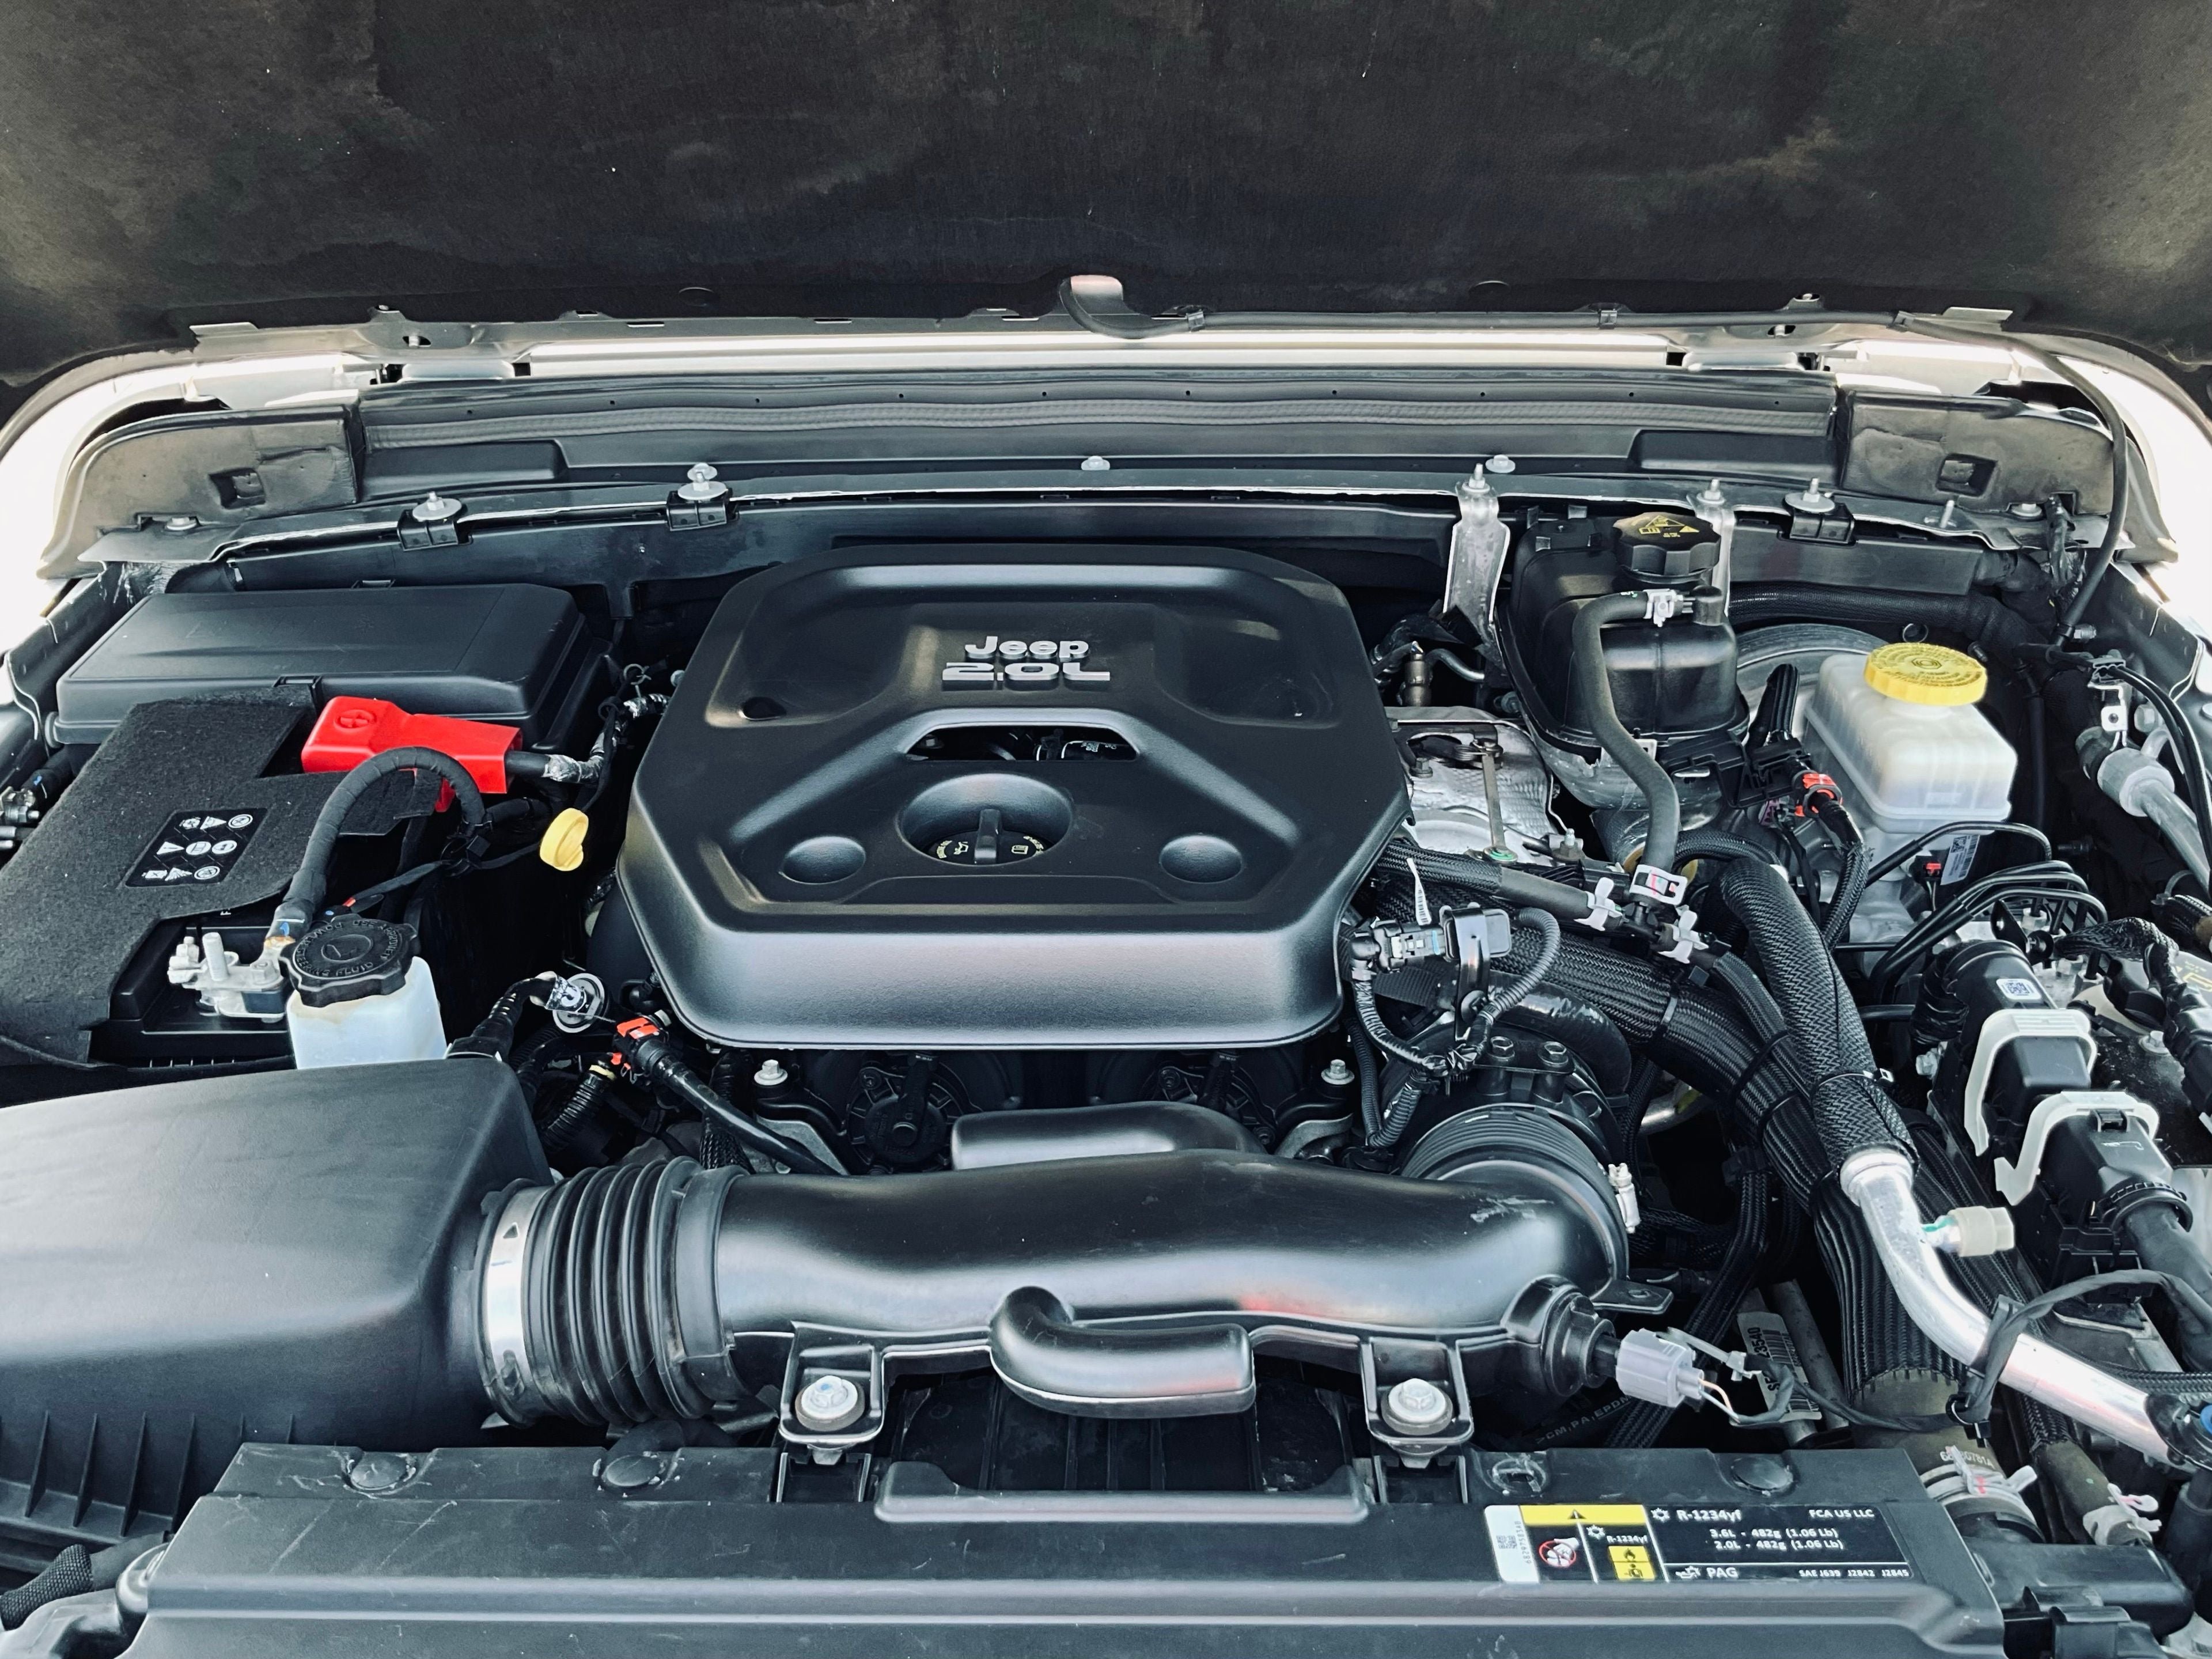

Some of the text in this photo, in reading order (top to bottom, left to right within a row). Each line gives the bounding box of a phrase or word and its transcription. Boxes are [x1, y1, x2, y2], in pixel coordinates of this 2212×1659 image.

[965, 636, 1089, 662] Jeep
[942, 662, 1111, 681] 2.0L
[1676, 1509, 1742, 1522] R-1234yf
[1808, 1509, 1874, 1518] FCA US LLC
[1709, 1528, 1736, 1539] 3.6L
[1751, 1528, 1782, 1539] 482g
[1786, 1528, 1817, 1539] (1.06
[1818, 1528, 1839, 1539] Lb)
[1606, 1535, 1648, 1544] R-1234yf
[1714, 1540, 1741, 1551] 2.0L
[1756, 1540, 1787, 1551] 482g
[1791, 1539, 1823, 1551] (1.06
[1824, 1539, 1844, 1550] Lb)
[1706, 1567, 1738, 1578] PAG
